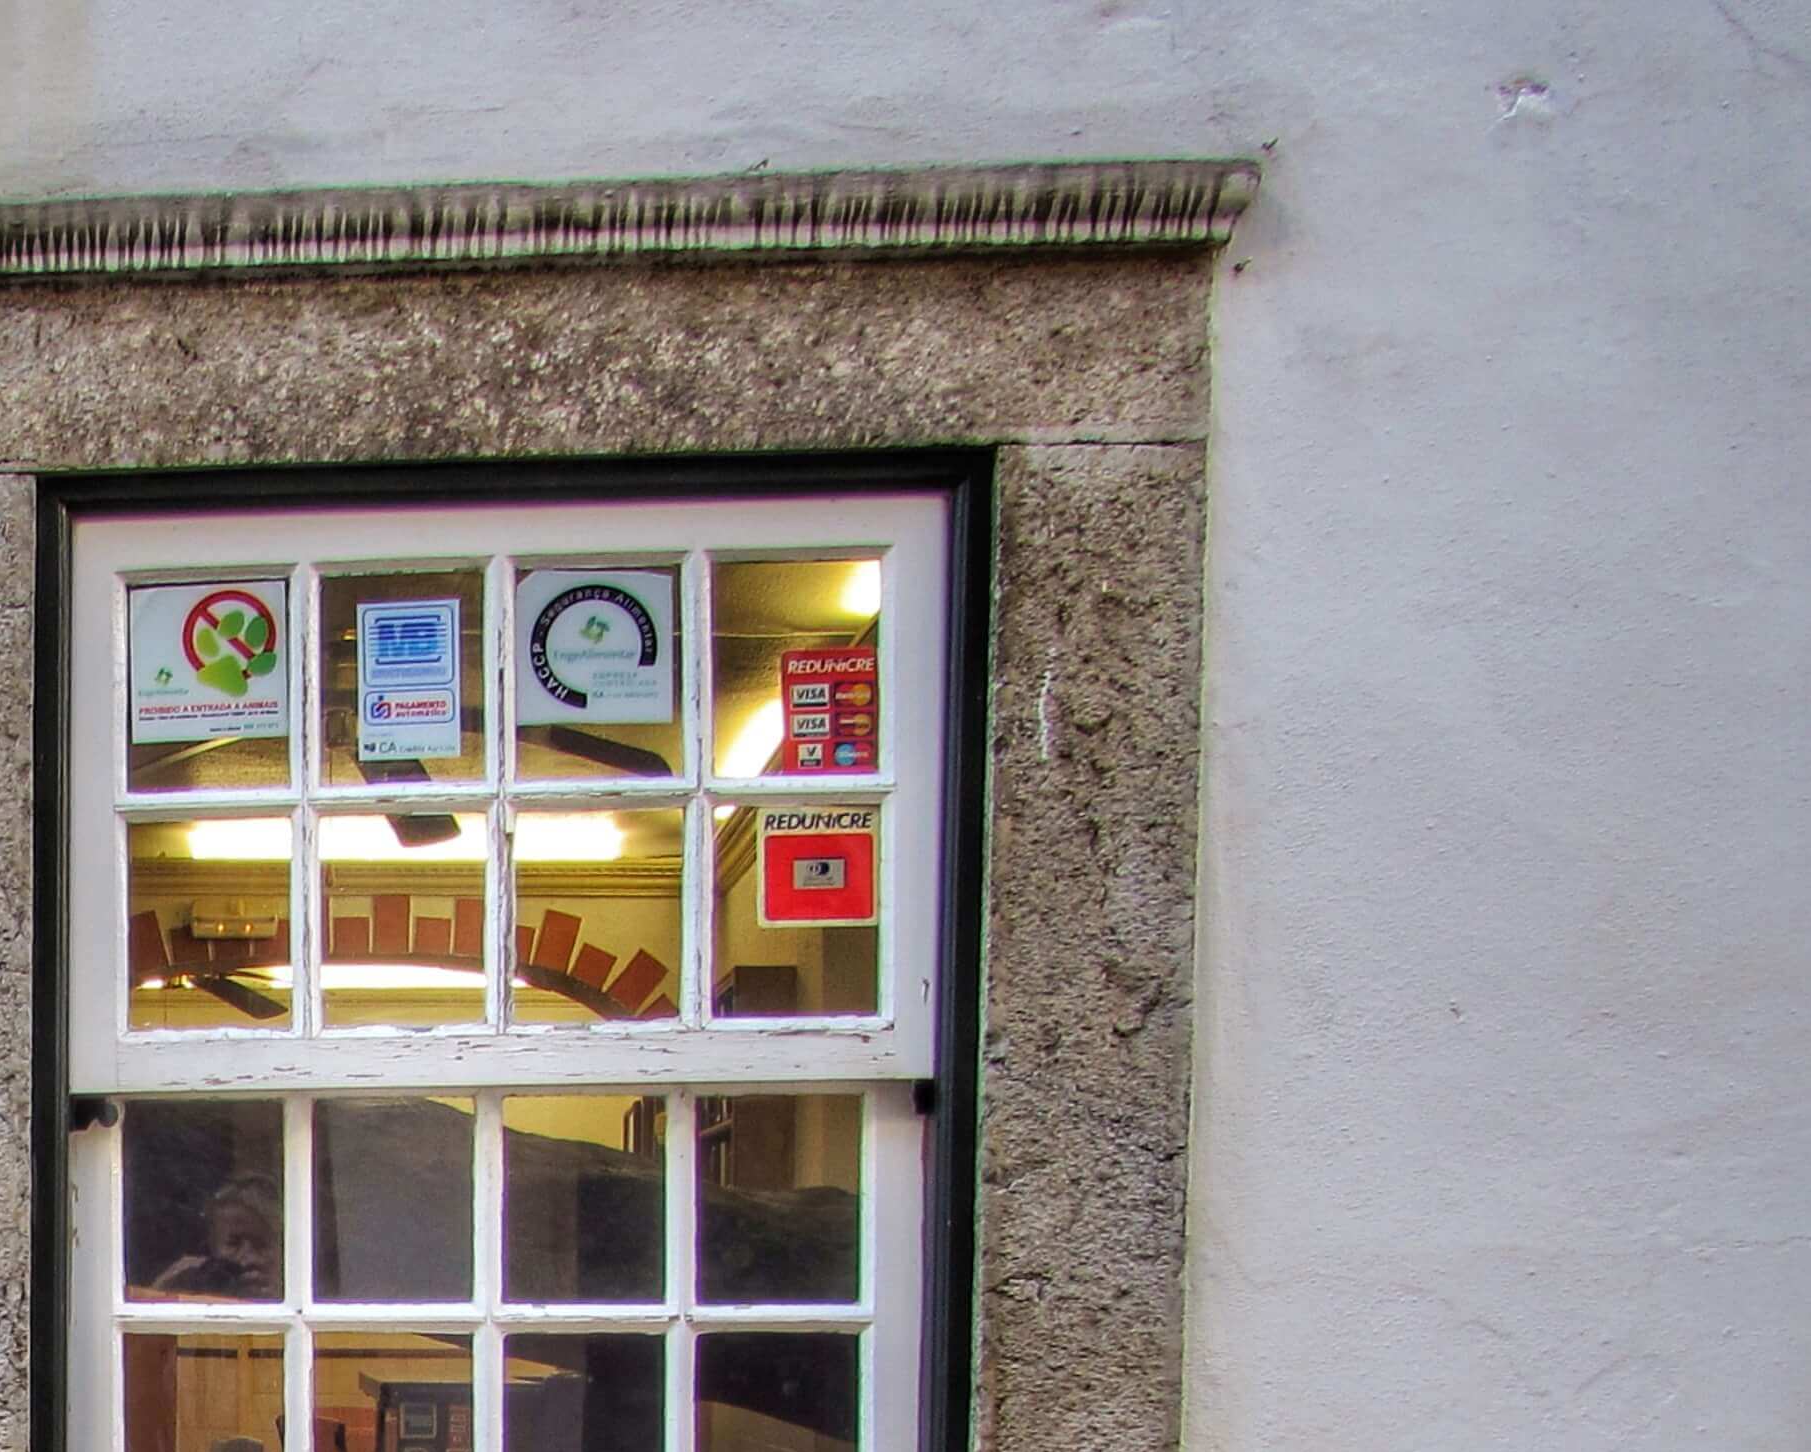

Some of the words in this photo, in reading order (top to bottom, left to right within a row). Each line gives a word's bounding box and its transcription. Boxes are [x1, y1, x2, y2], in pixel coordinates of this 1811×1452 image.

[532, 642, 569, 699] HACCP
[796, 687, 826, 699] VISA
[796, 717, 826, 730] VISA
